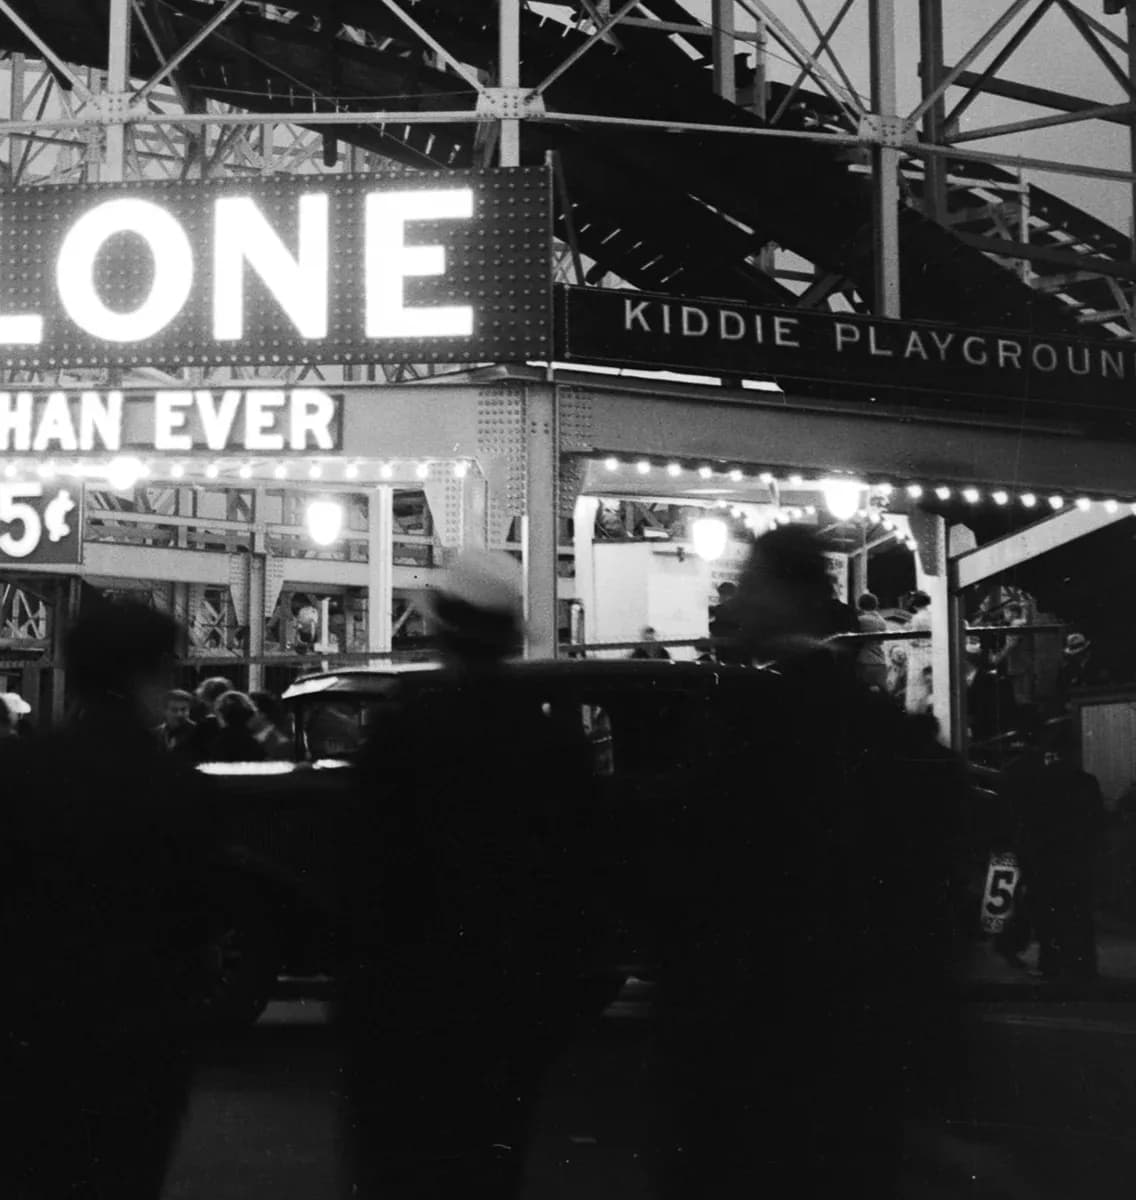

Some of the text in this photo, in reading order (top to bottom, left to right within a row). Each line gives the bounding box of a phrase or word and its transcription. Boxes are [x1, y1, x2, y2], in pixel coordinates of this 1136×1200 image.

[624, 299, 1136, 379] KIDDIE PLAYGROUN
[154, 389, 337, 452] EVER
[985, 869, 1015, 916] 5
